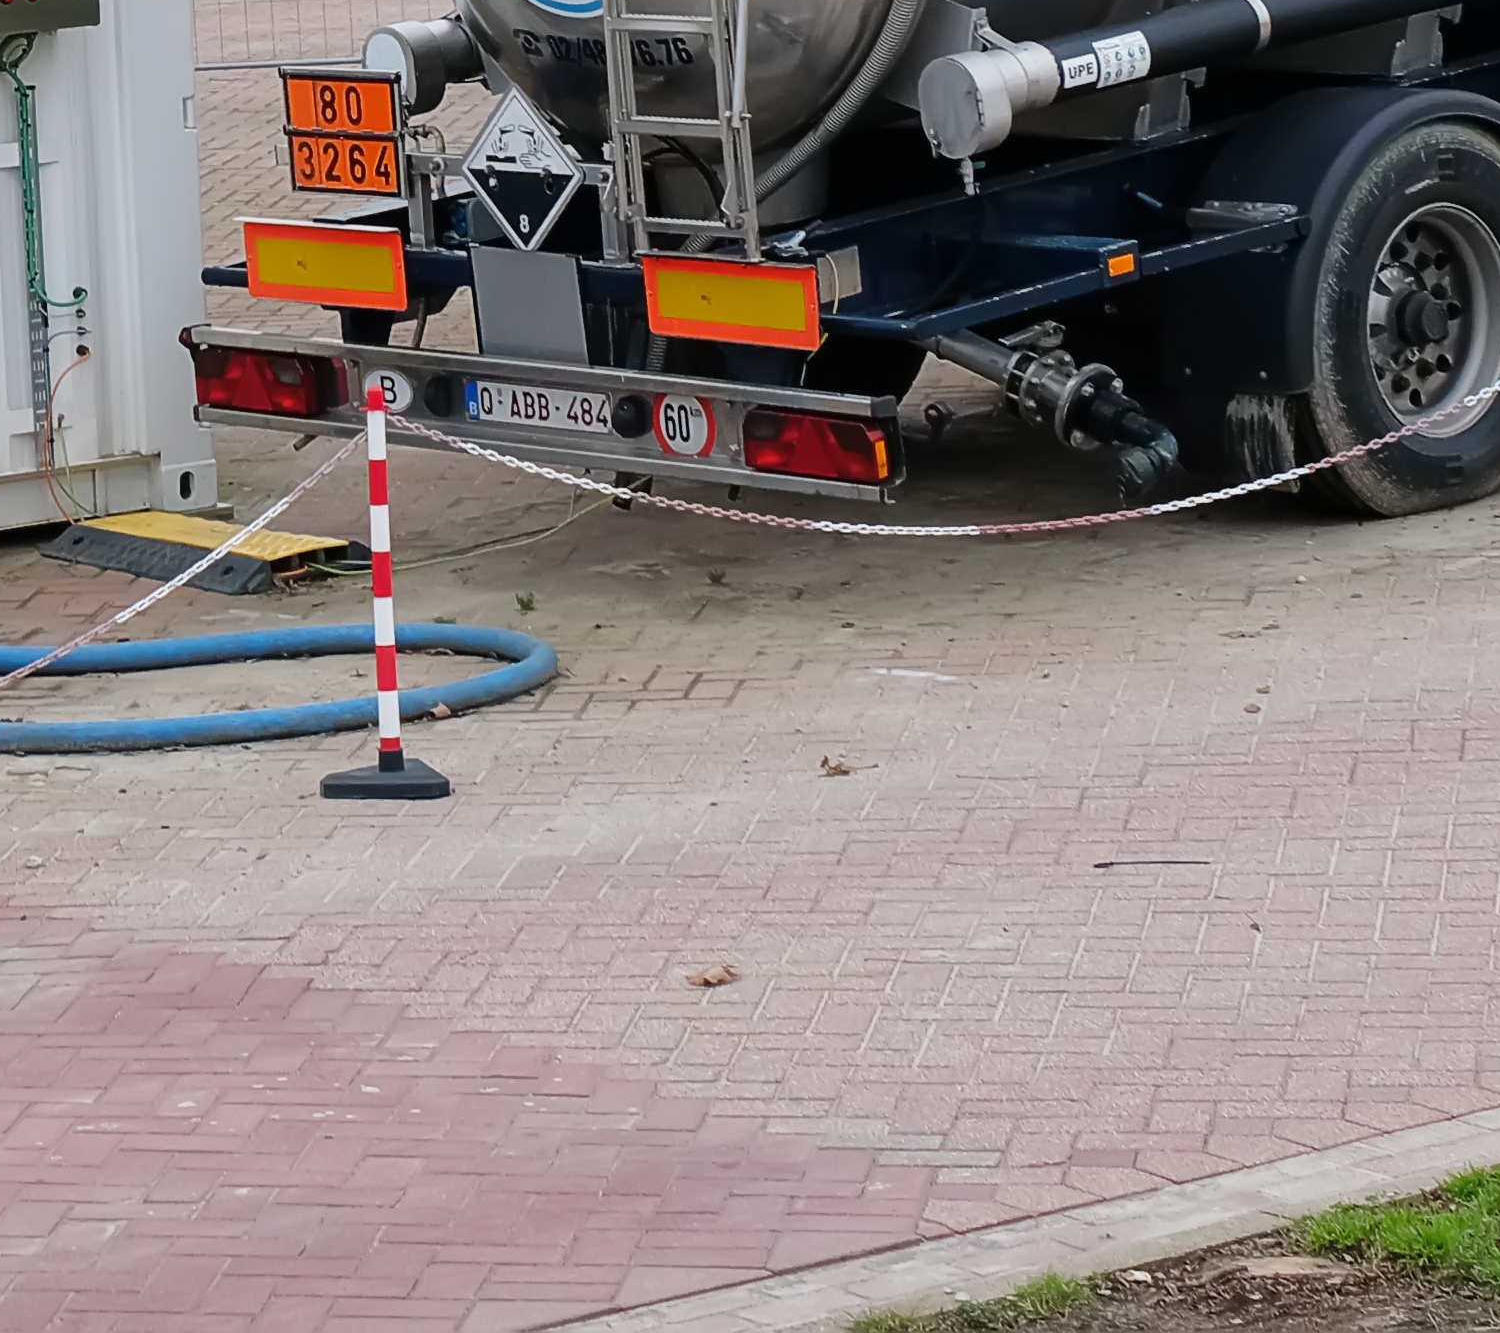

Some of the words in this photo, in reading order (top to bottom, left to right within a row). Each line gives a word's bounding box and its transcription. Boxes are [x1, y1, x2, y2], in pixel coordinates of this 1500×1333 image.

[318, 84, 363, 126] 80
[297, 140, 391, 186] 3264
[519, 214, 530, 234] 8
[381, 375, 398, 405] B
[468, 401, 478, 416] B
[663, 403, 691, 443] 60
